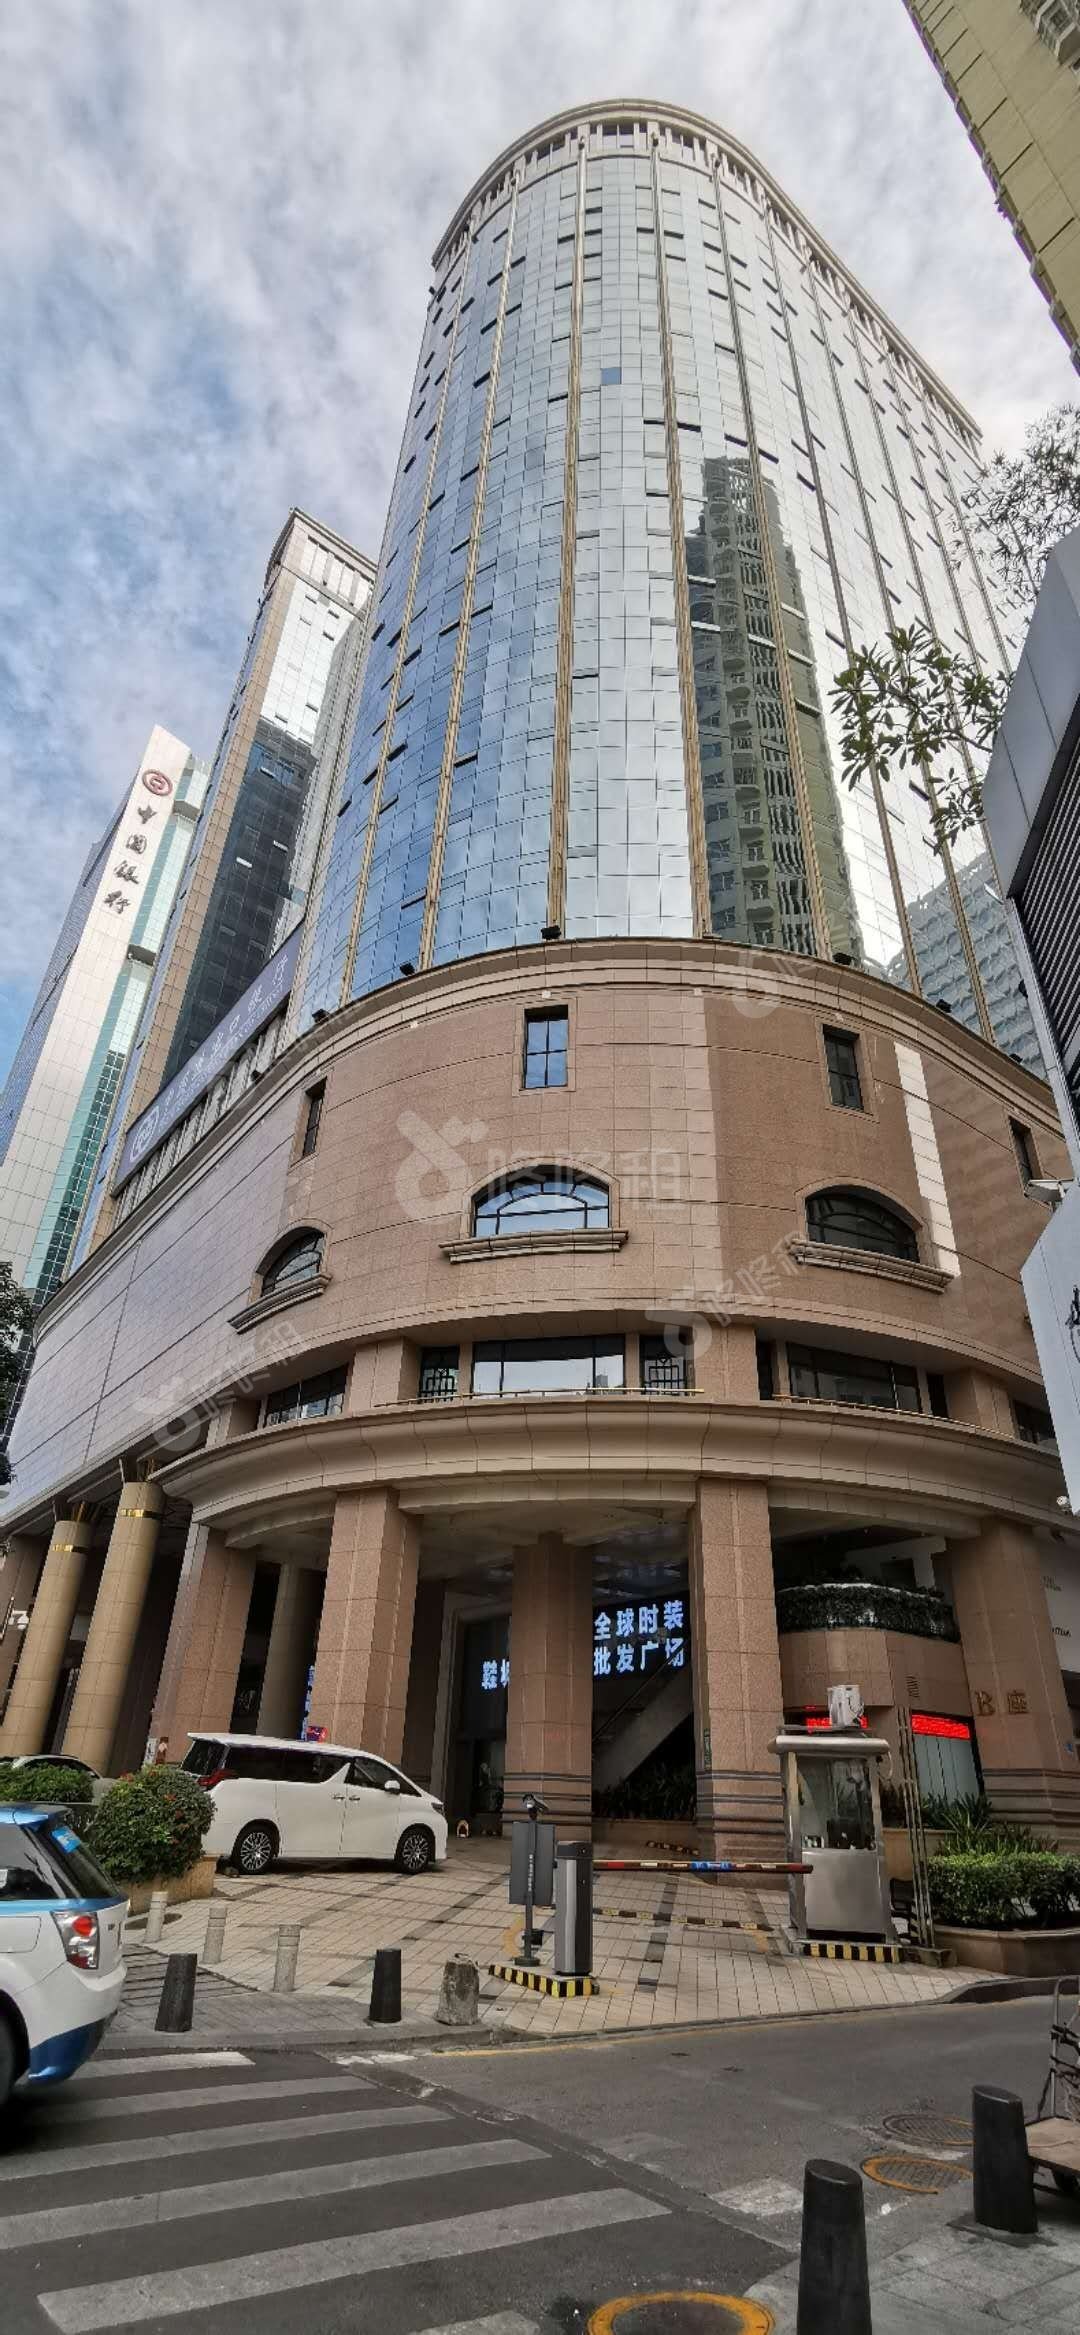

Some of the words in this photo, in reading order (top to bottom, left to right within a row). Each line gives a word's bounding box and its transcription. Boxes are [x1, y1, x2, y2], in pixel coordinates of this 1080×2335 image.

[104, 804, 158, 915] 中国银行
[594, 1600, 684, 1641] 全球时装
[593, 1637, 684, 1676] 批发广场
